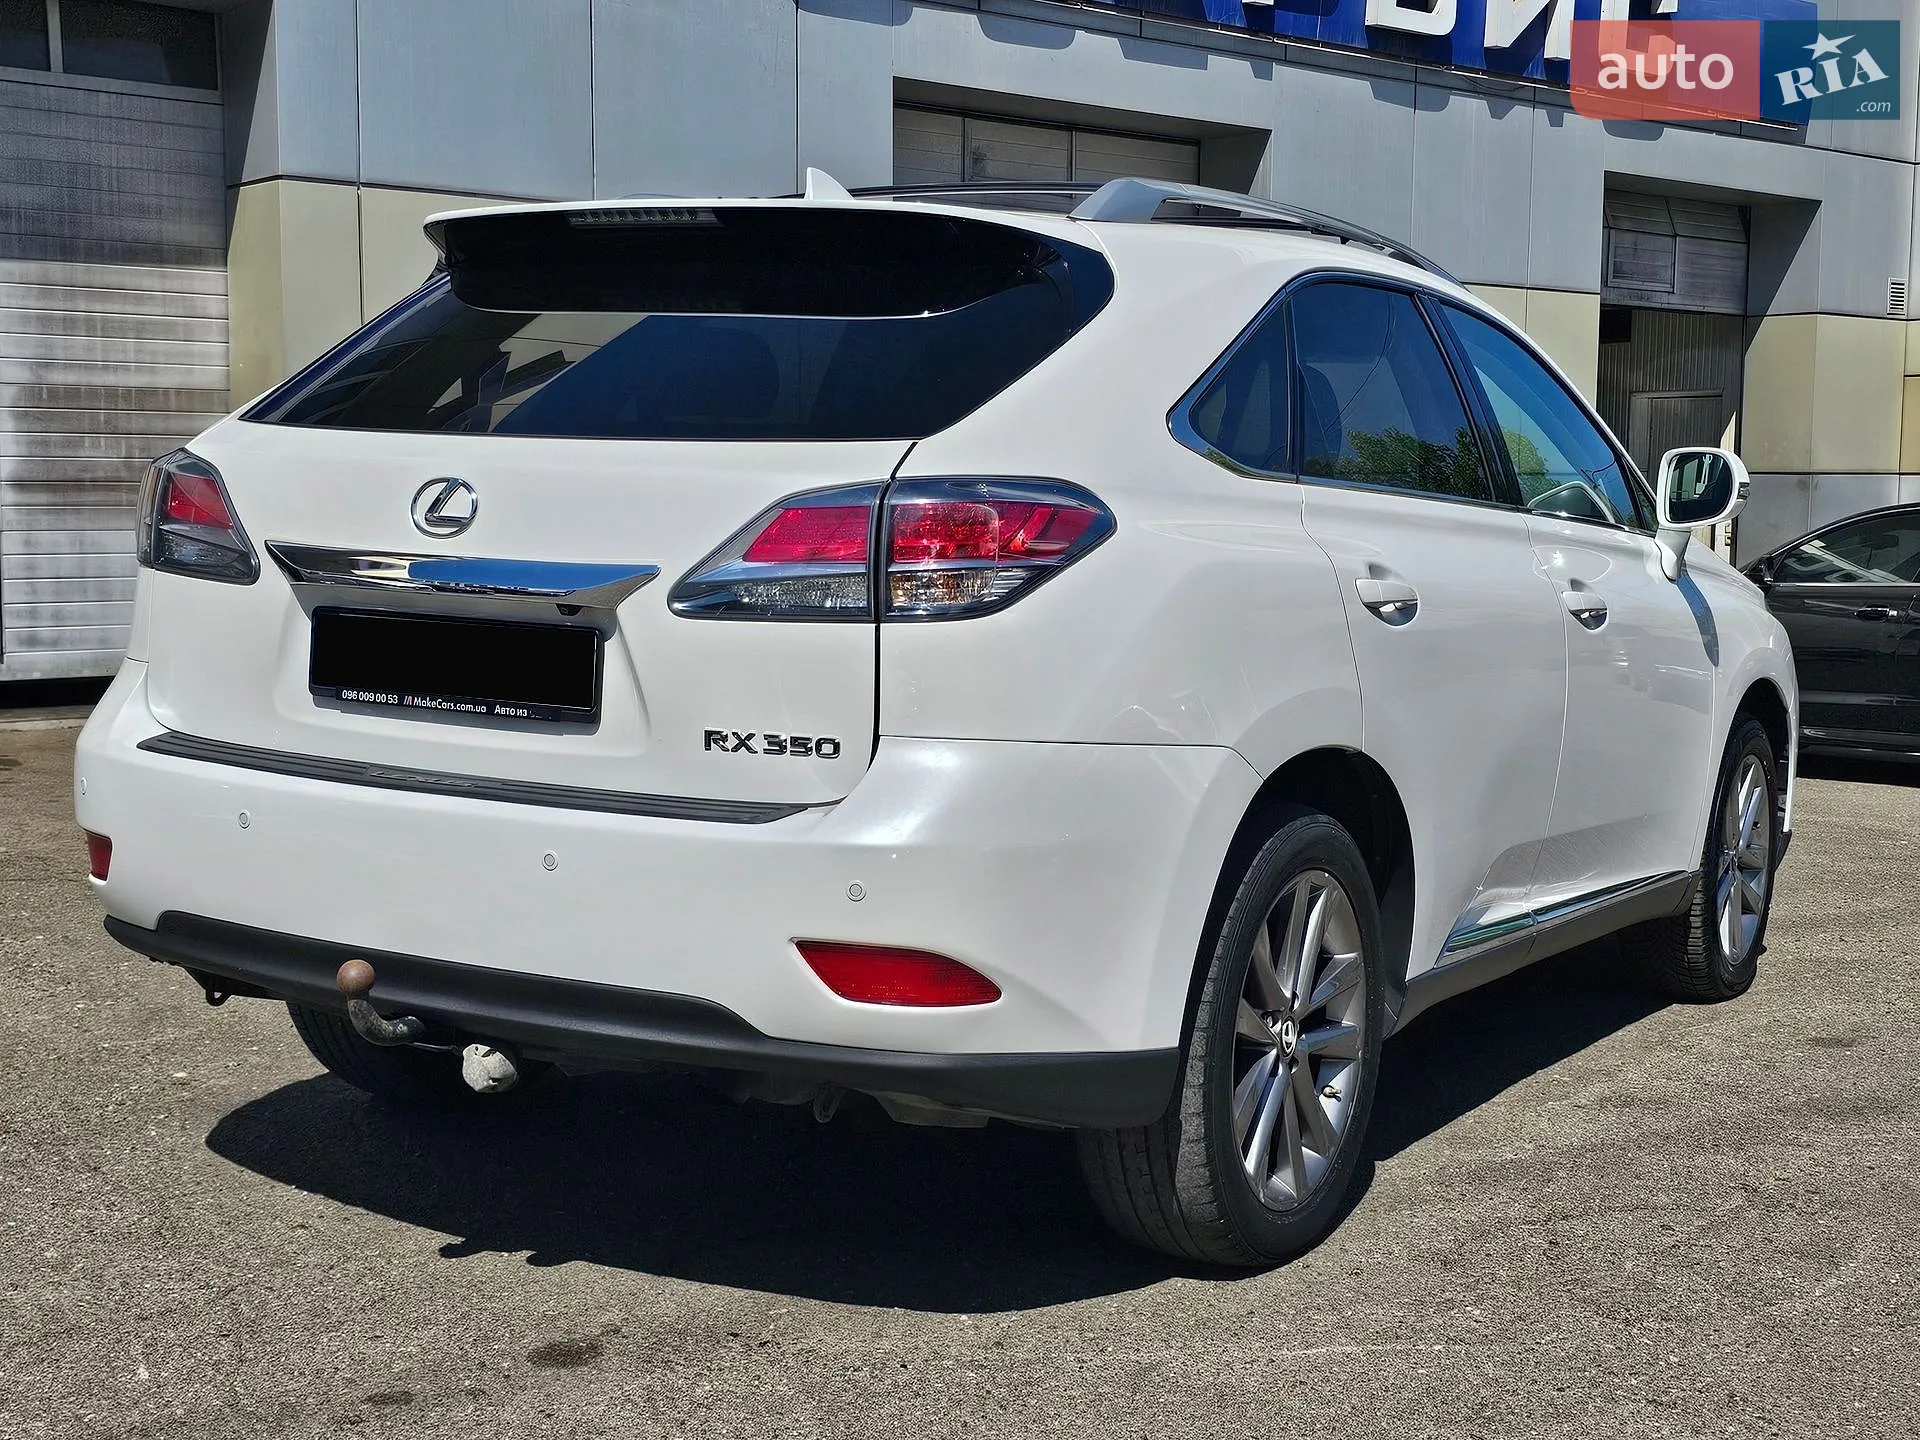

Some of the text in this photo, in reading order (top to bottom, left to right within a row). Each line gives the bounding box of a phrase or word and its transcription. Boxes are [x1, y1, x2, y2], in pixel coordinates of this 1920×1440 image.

[342, 689, 487, 713] 096 009 00 53 MakeCars.com.ua
[494, 704, 516, 716] Авто
[516, 708, 528, 717] из
[704, 728, 842, 760] RX 350
